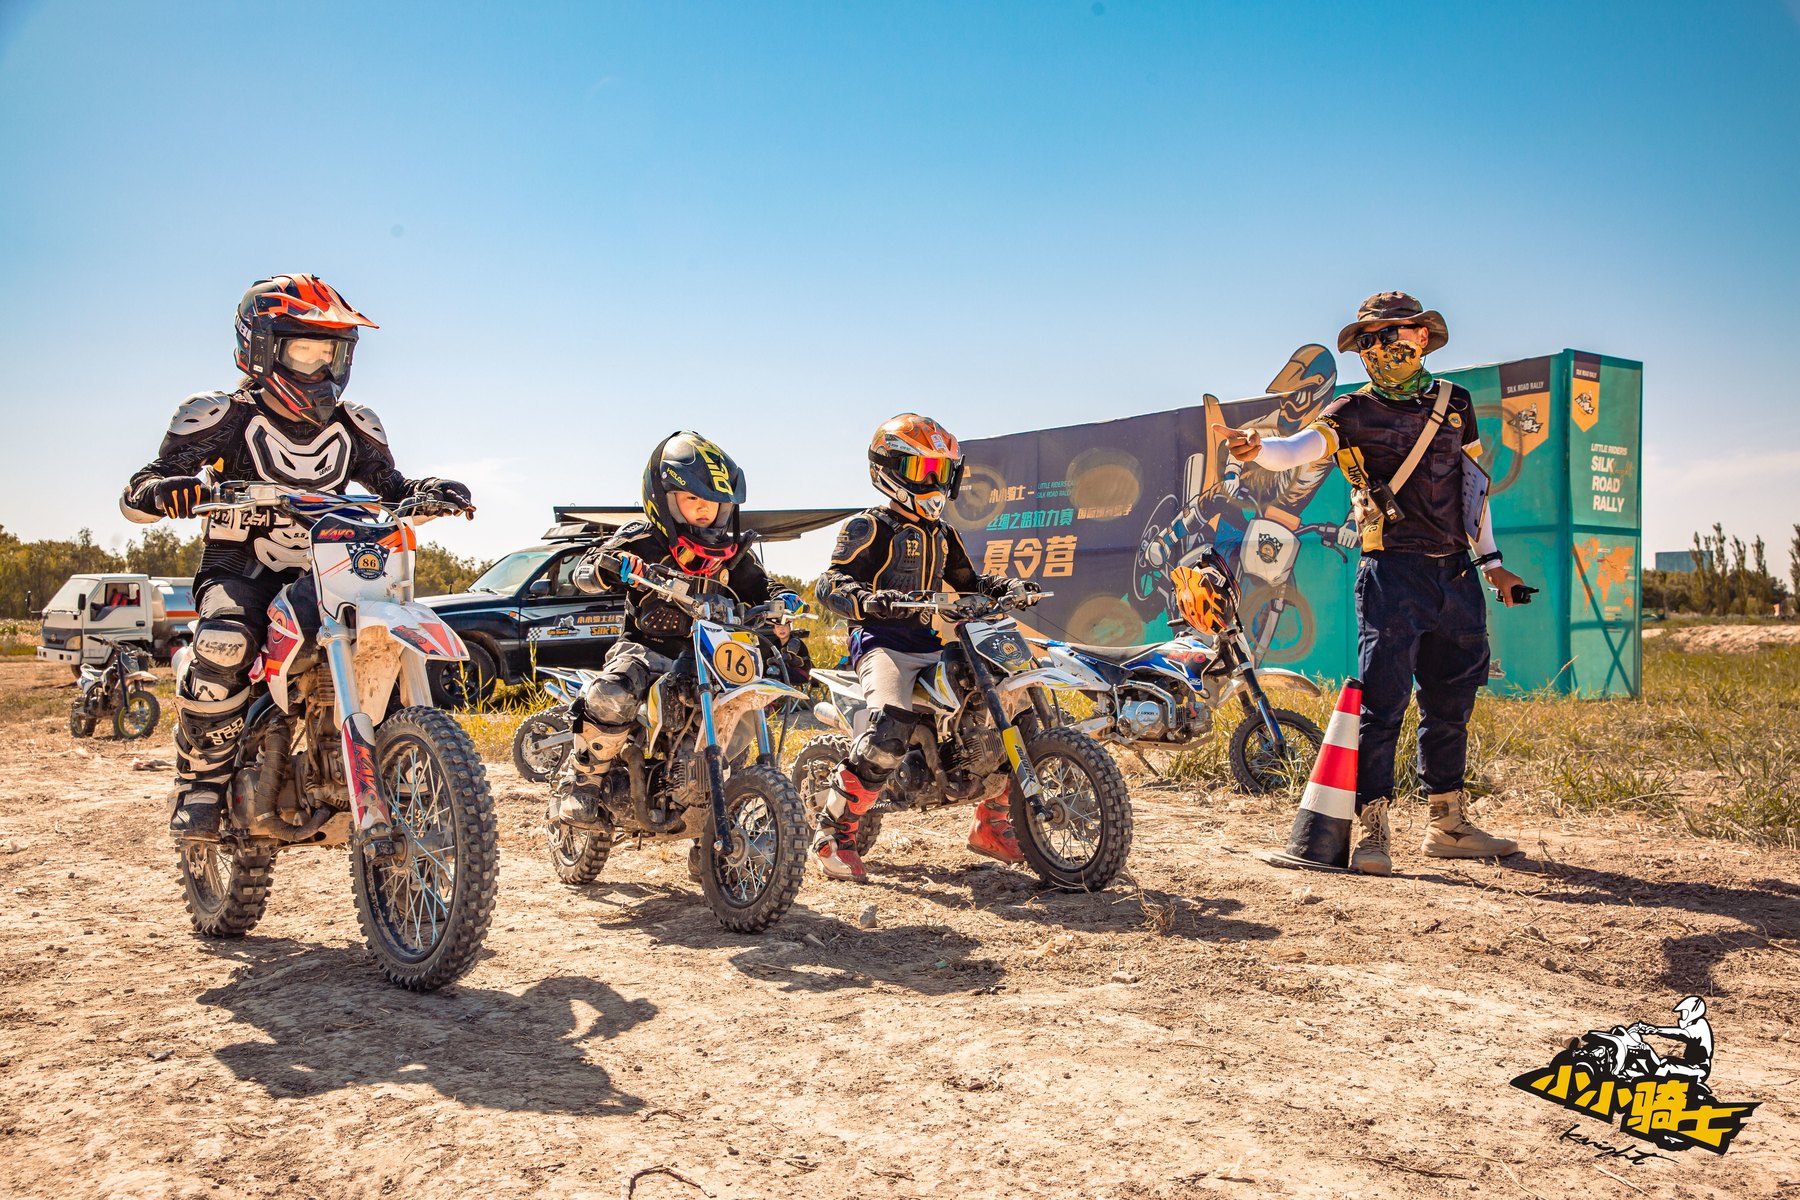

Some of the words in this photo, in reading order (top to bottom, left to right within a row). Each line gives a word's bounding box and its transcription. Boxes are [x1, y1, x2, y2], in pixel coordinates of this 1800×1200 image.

[1506, 385, 1518, 394] SILK
[1517, 383, 1530, 392] ROAD
[1529, 381, 1545, 390] RALLY
[1591, 443, 1608, 453] LITTLE
[1607, 445, 1628, 456] RIDERS
[1590, 455, 1615, 473] SILK
[1592, 475, 1621, 493] ROAD
[1593, 495, 1625, 513] RALLY
[985, 507, 1075, 531] 丝绸之路拉力赛
[317, 528, 356, 541] KAYO
[362, 558, 376, 568] 86
[982, 535, 1078, 579] 夏令营
[724, 649, 748, 677] 16
